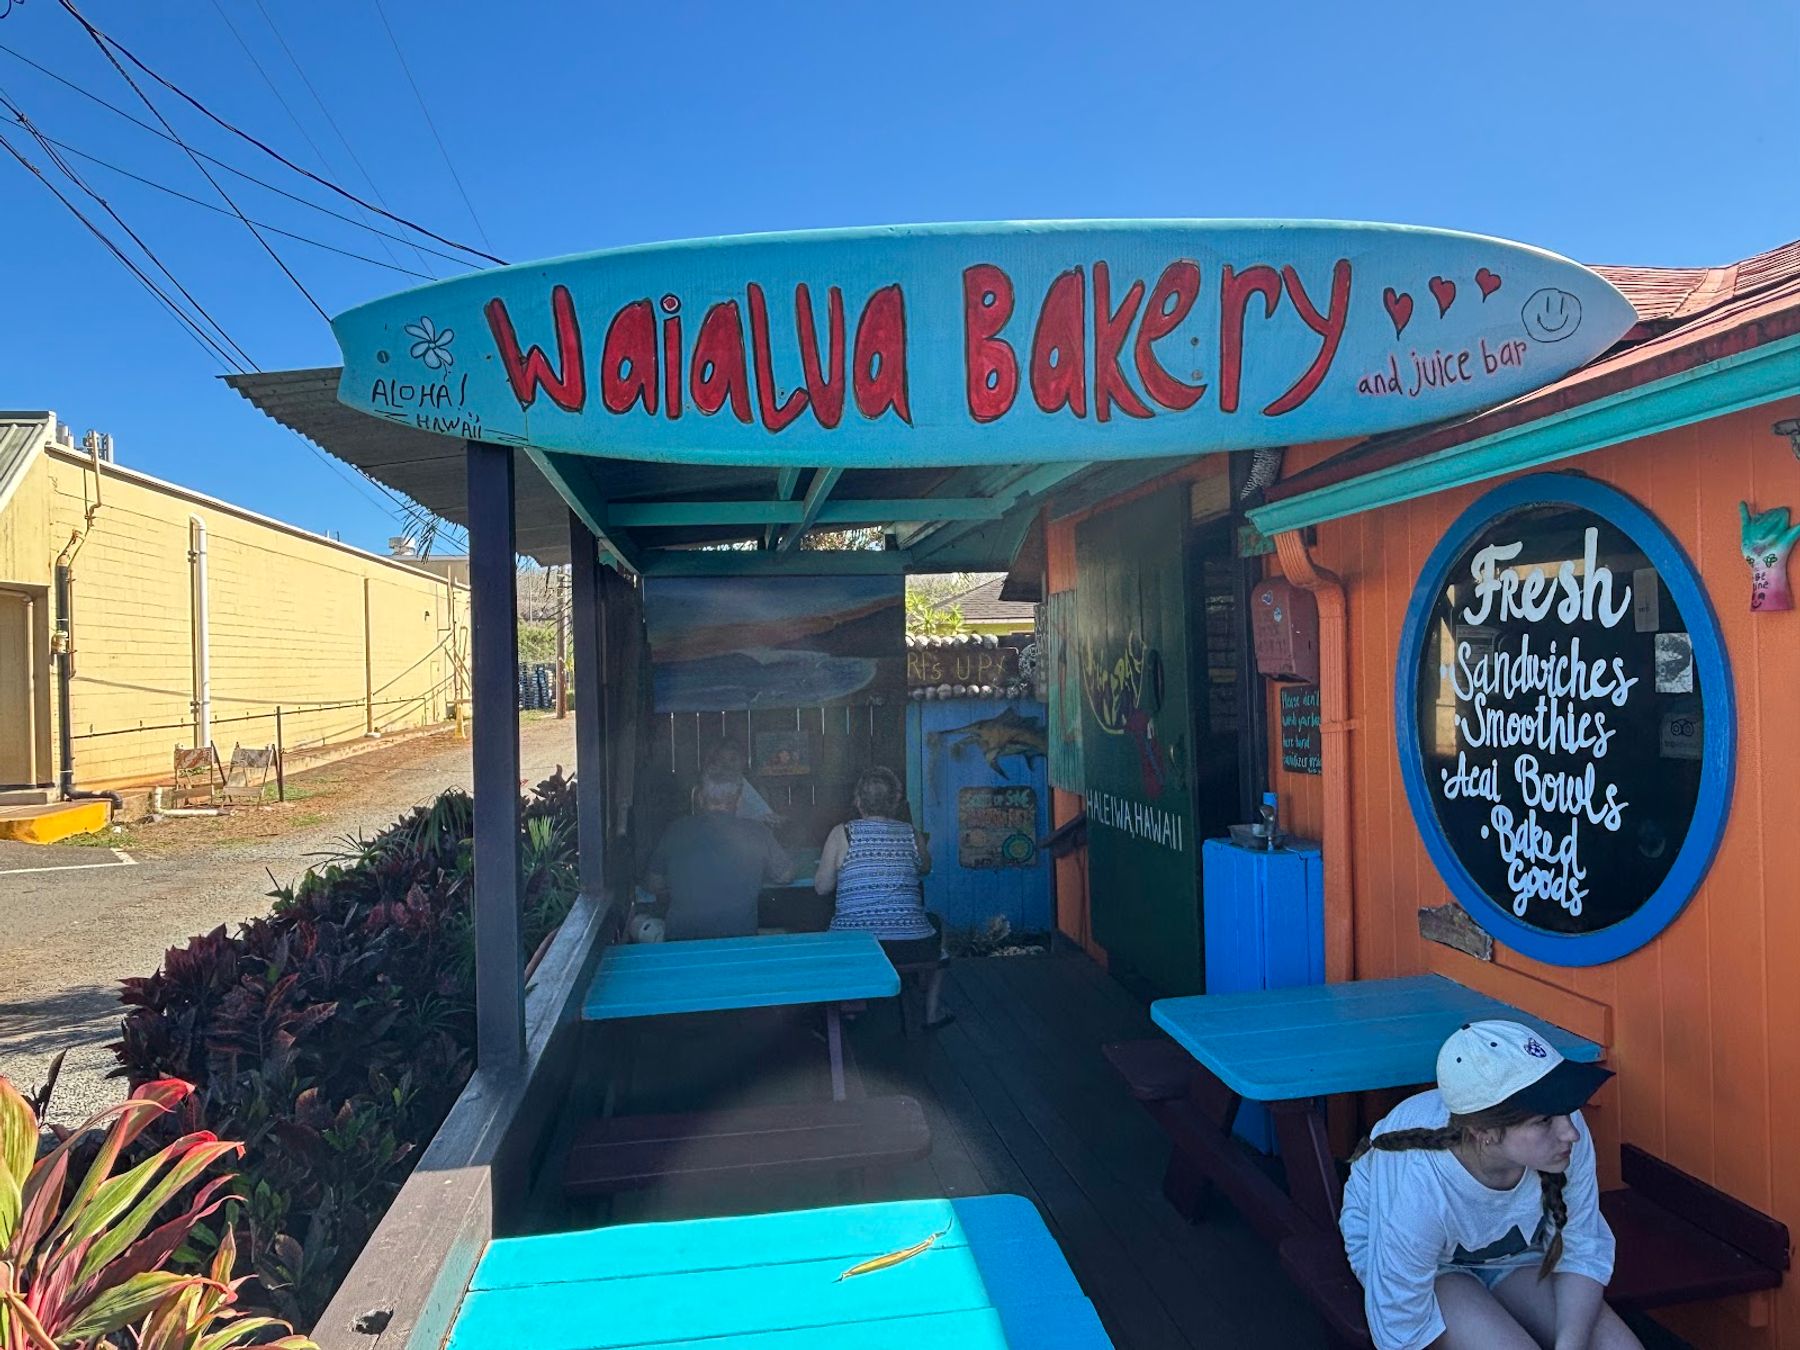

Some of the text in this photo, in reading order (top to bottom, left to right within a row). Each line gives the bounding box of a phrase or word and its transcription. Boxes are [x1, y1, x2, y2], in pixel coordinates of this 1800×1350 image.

[963, 258, 1353, 424] Bakery
[1358, 339, 1527, 397] and juice bar
[371, 373, 467, 410] ALOHA!
[1452, 633, 1640, 707] Sandwiches
[1461, 692, 1617, 758] Smoothies
[1444, 751, 1629, 831] Acai Bowls
[1134, 801, 1183, 852] HAWAII
[1490, 804, 1586, 880] Baked
[1507, 858, 1589, 917] Goods
